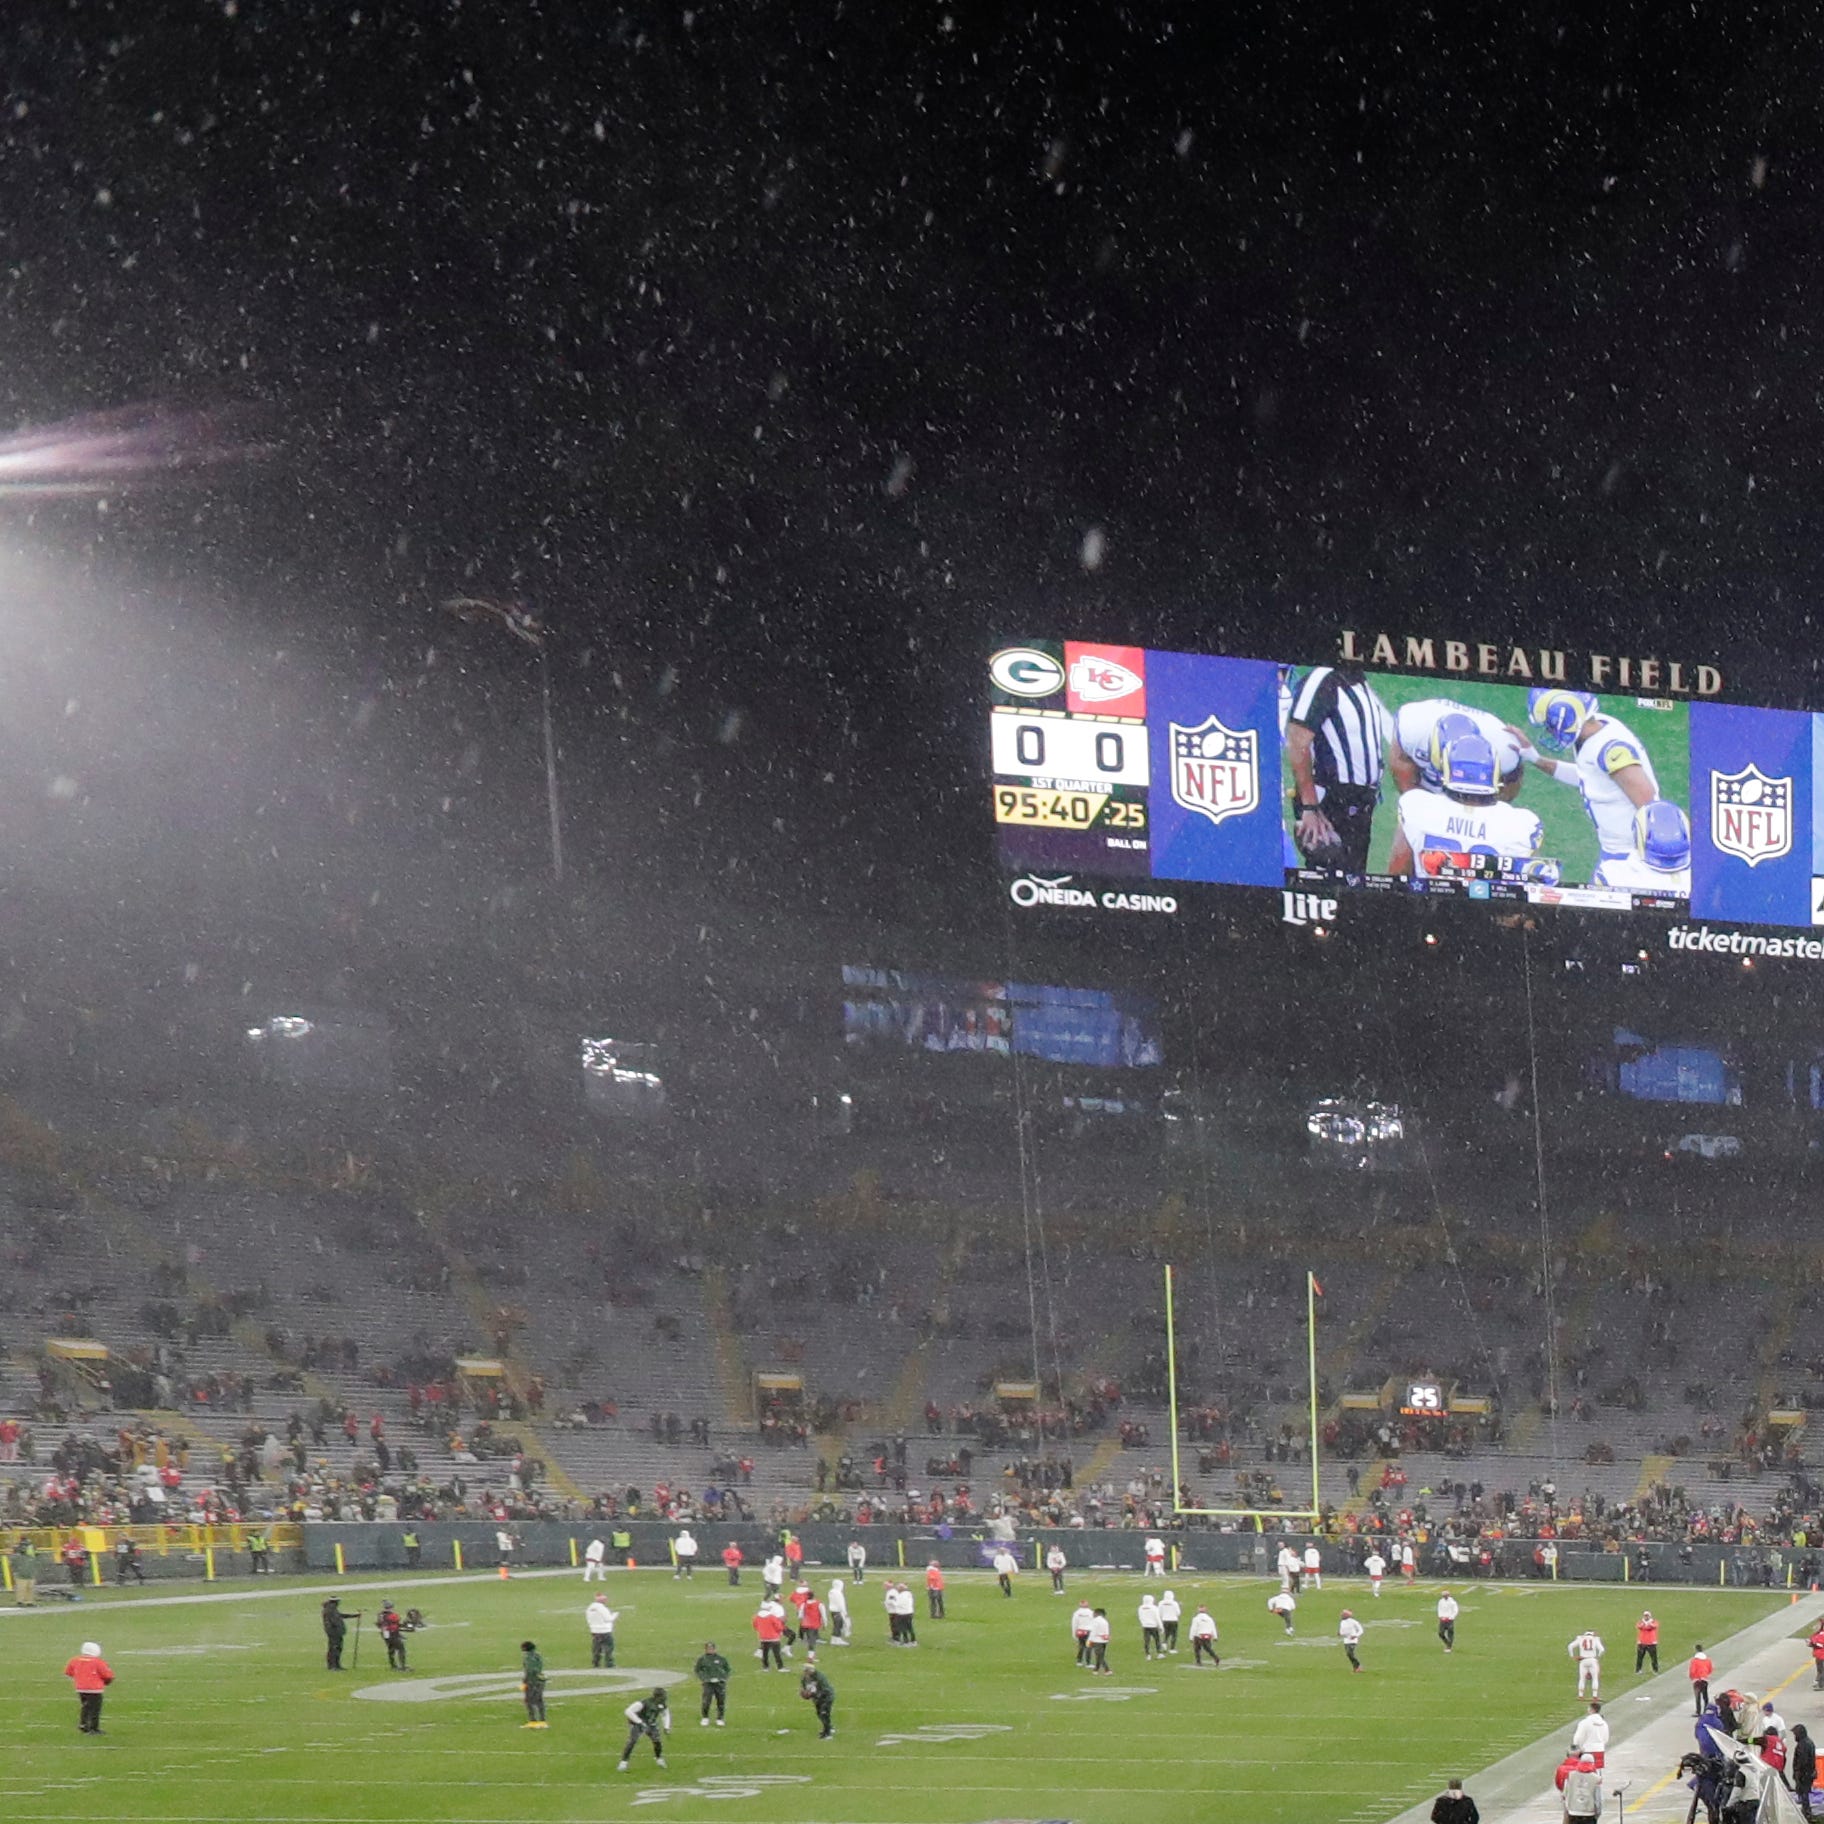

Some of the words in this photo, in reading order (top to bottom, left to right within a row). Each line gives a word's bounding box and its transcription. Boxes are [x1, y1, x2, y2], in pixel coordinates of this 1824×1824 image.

[1341, 630, 1566, 681] LAMBEAU
[1591, 655, 1723, 694] FIELD
[1016, 725, 1045, 766] 0
[1096, 732, 1124, 772] 0
[1032, 777, 1055, 790] 1ST
[1056, 779, 1114, 794] QUARTER
[1184, 762, 1247, 805] NFL
[999, 791, 1091, 823] 95:40
[1107, 837, 1131, 850] BALL
[1132, 839, 1148, 850] ON
[1446, 816, 1487, 840] AVILA
[1723, 808, 1780, 848] NFL
[1470, 854, 1485, 869] 13
[1497, 856, 1513, 871] 13
[1010, 878, 1098, 908] ONEIDA
[1102, 892, 1178, 914] CASINO
[1282, 890, 1338, 925] Lite
[1411, 1387, 1437, 1407] 25
[1582, 1639, 1603, 1651] 41
[630, 1774, 813, 1807] 30
